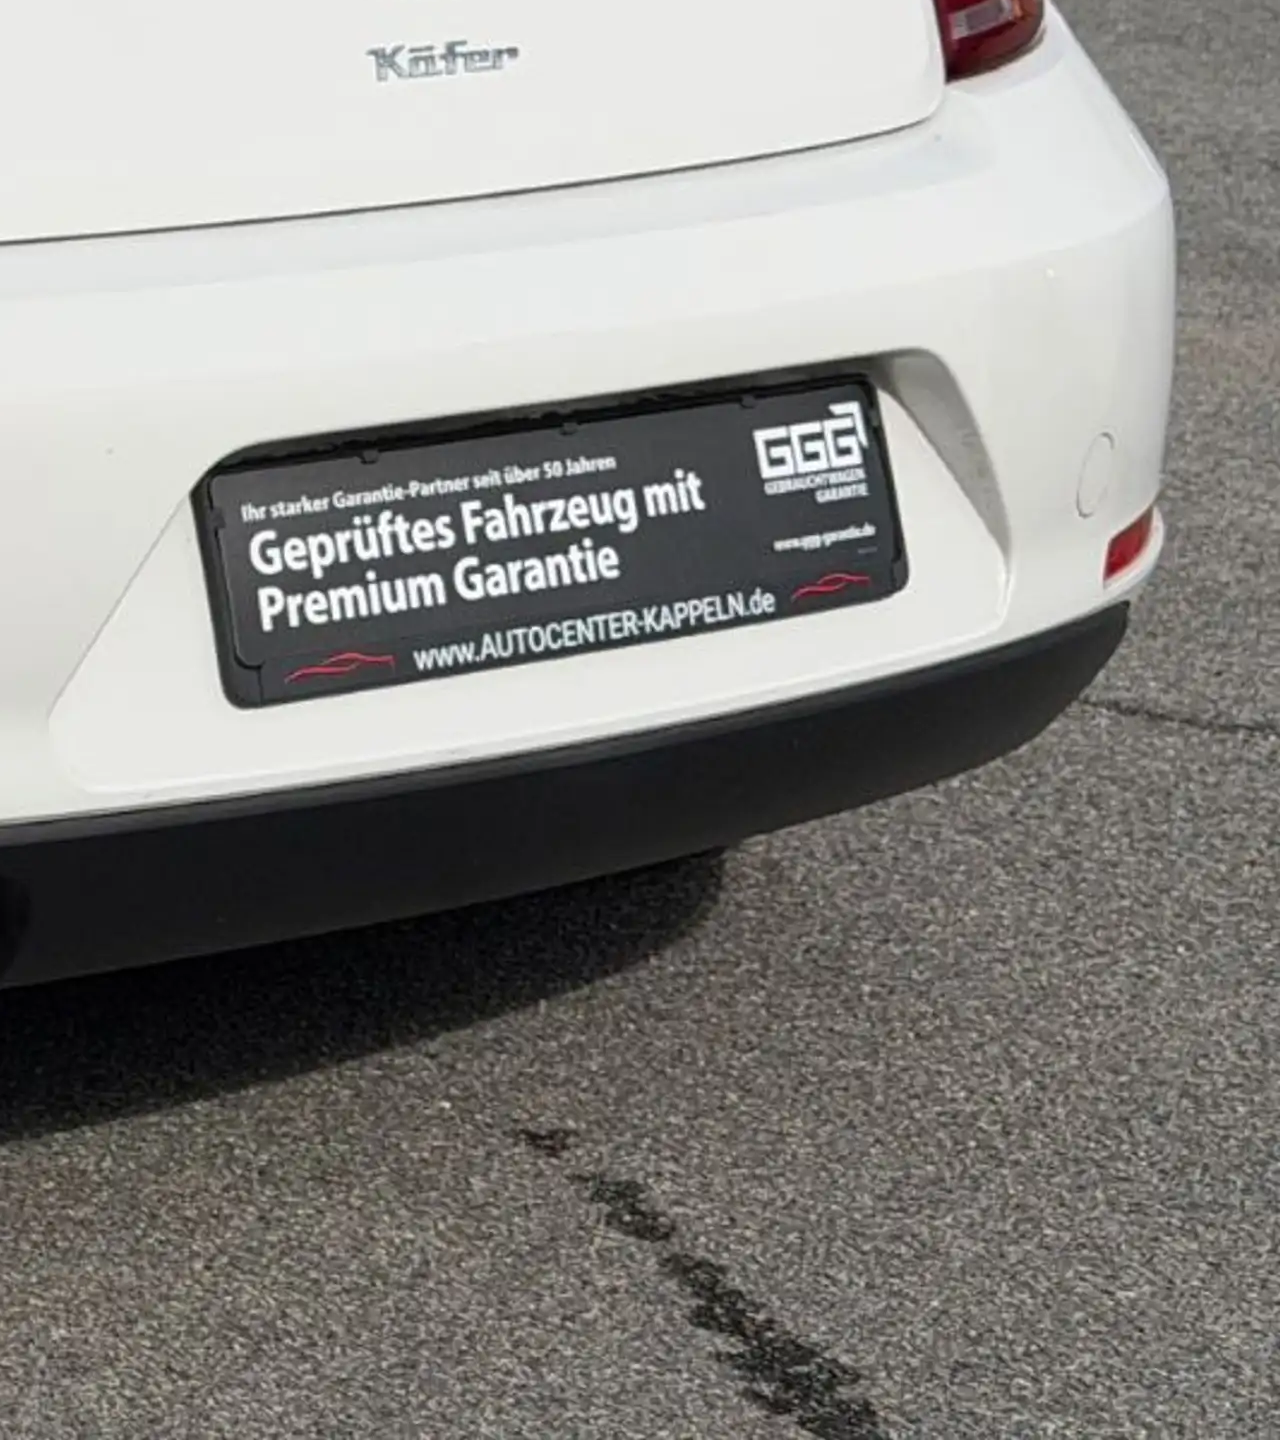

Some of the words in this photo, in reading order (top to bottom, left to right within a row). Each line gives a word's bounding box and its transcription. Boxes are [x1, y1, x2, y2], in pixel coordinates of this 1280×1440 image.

[365, 40, 519, 82] Käfer
[241, 502, 266, 522] Ihr
[270, 495, 330, 519] starker
[332, 477, 469, 509] Garantie-Partner
[473, 468, 502, 489] seit
[504, 464, 540, 485] über
[543, 461, 563, 480] 50
[566, 455, 617, 476] Jahren
[249, 510, 456, 580] Geprüftes
[460, 492, 638, 545] Fahrzeug
[643, 468, 706, 517] mit
[257, 569, 448, 633] Premium
[453, 537, 621, 602] Garantie
[413, 587, 776, 672] www.AUTOCENTER-KAPPELN.de
